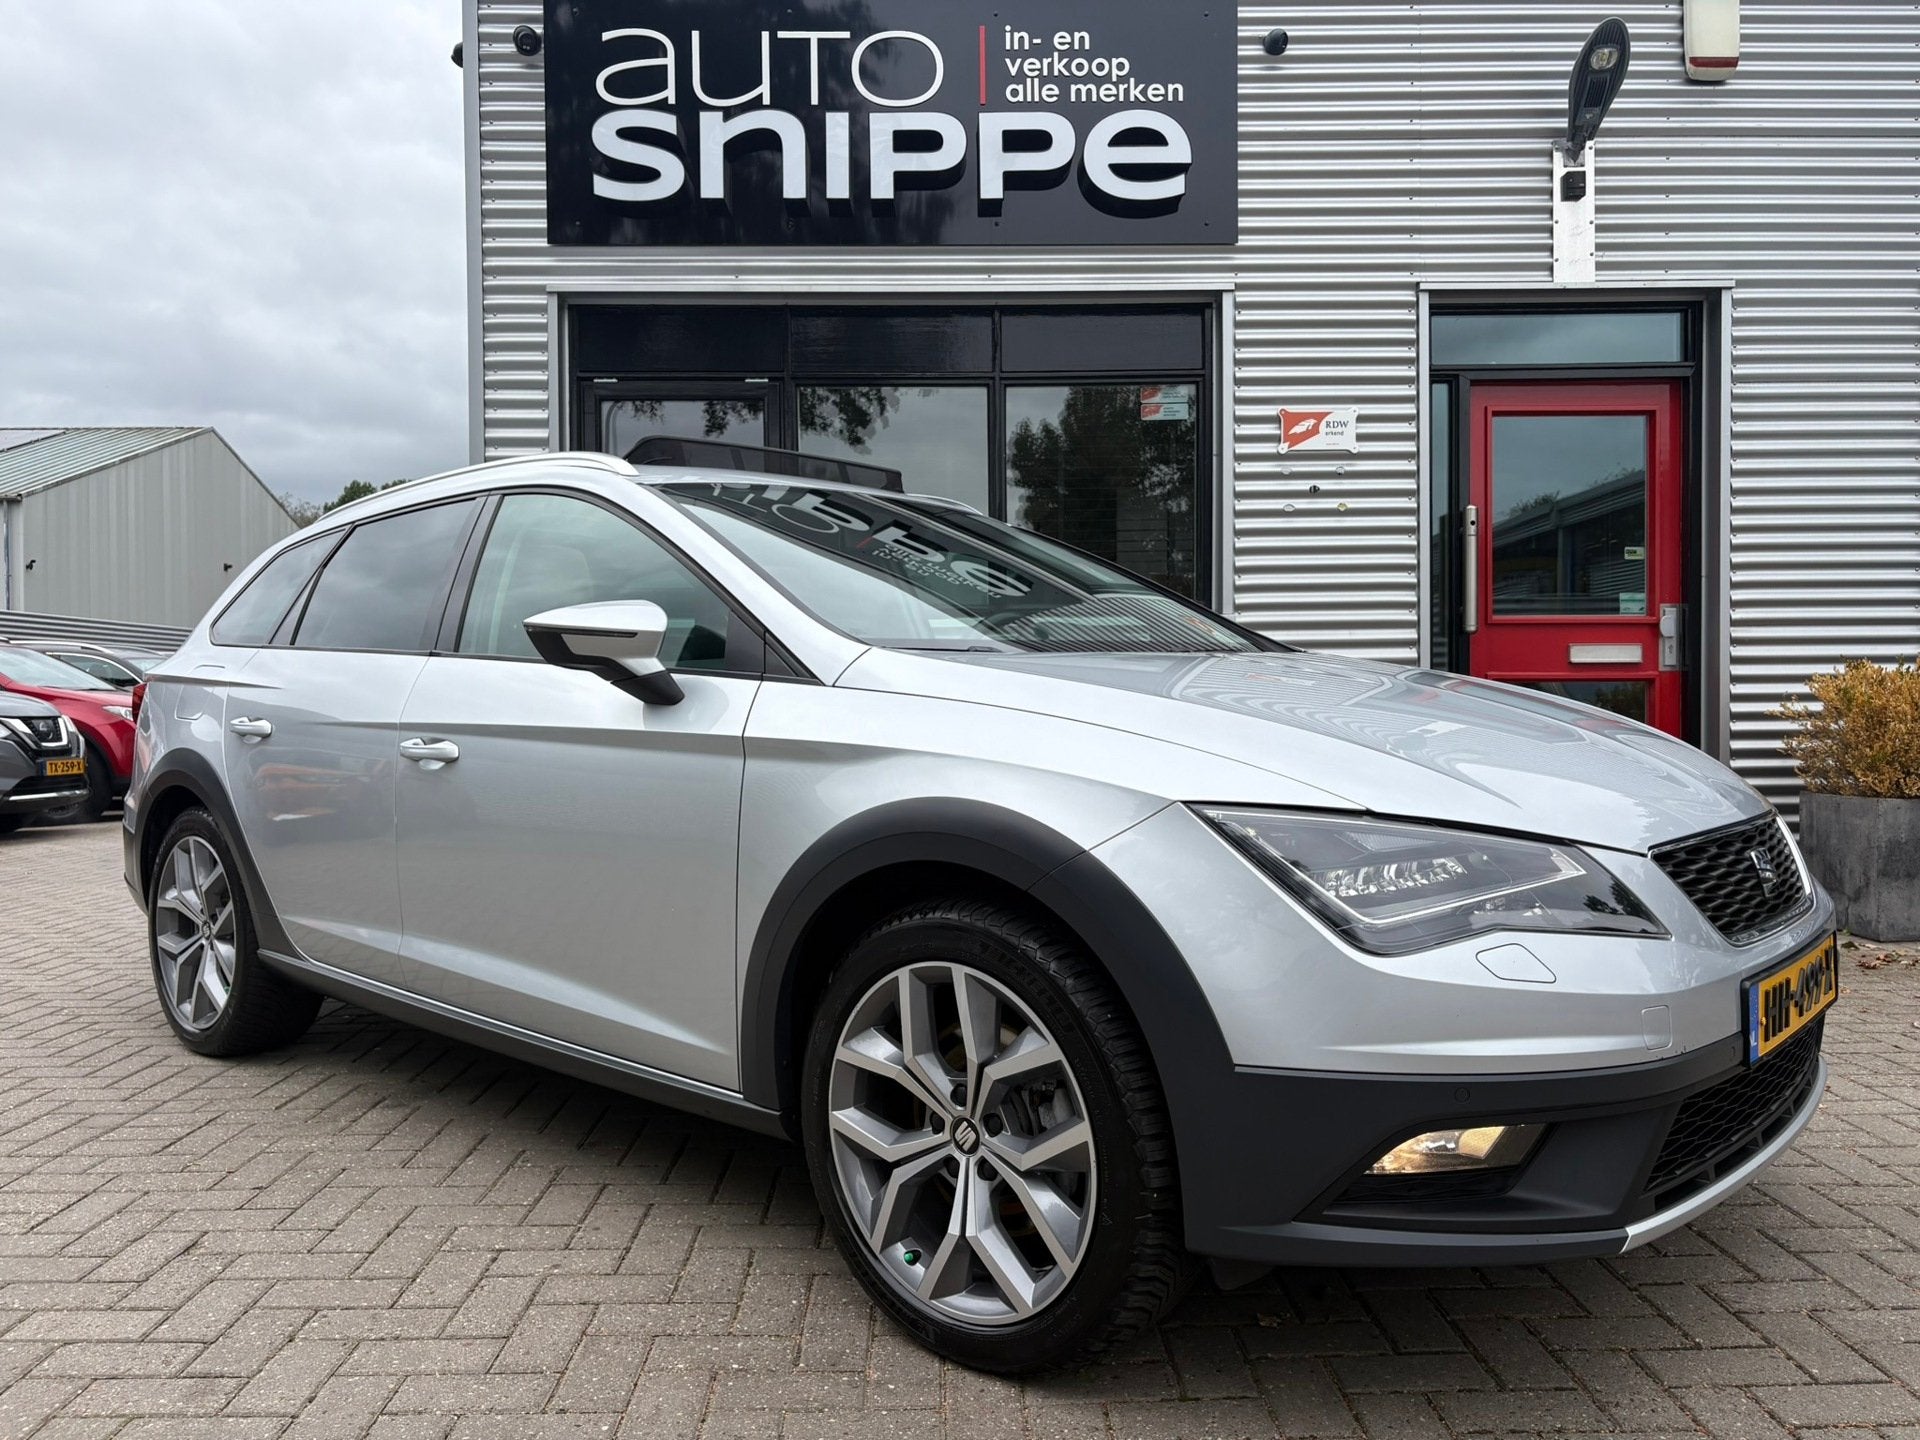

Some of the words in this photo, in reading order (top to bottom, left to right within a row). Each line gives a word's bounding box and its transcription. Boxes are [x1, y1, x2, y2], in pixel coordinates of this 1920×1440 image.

[1004, 24, 1042, 51] in-
[1053, 33, 1090, 51] en
[1004, 51, 1131, 82] verkoop
[1005, 77, 1060, 103] alle
[1070, 77, 1185, 103] merken
[1325, 420, 1349, 429] RDW
